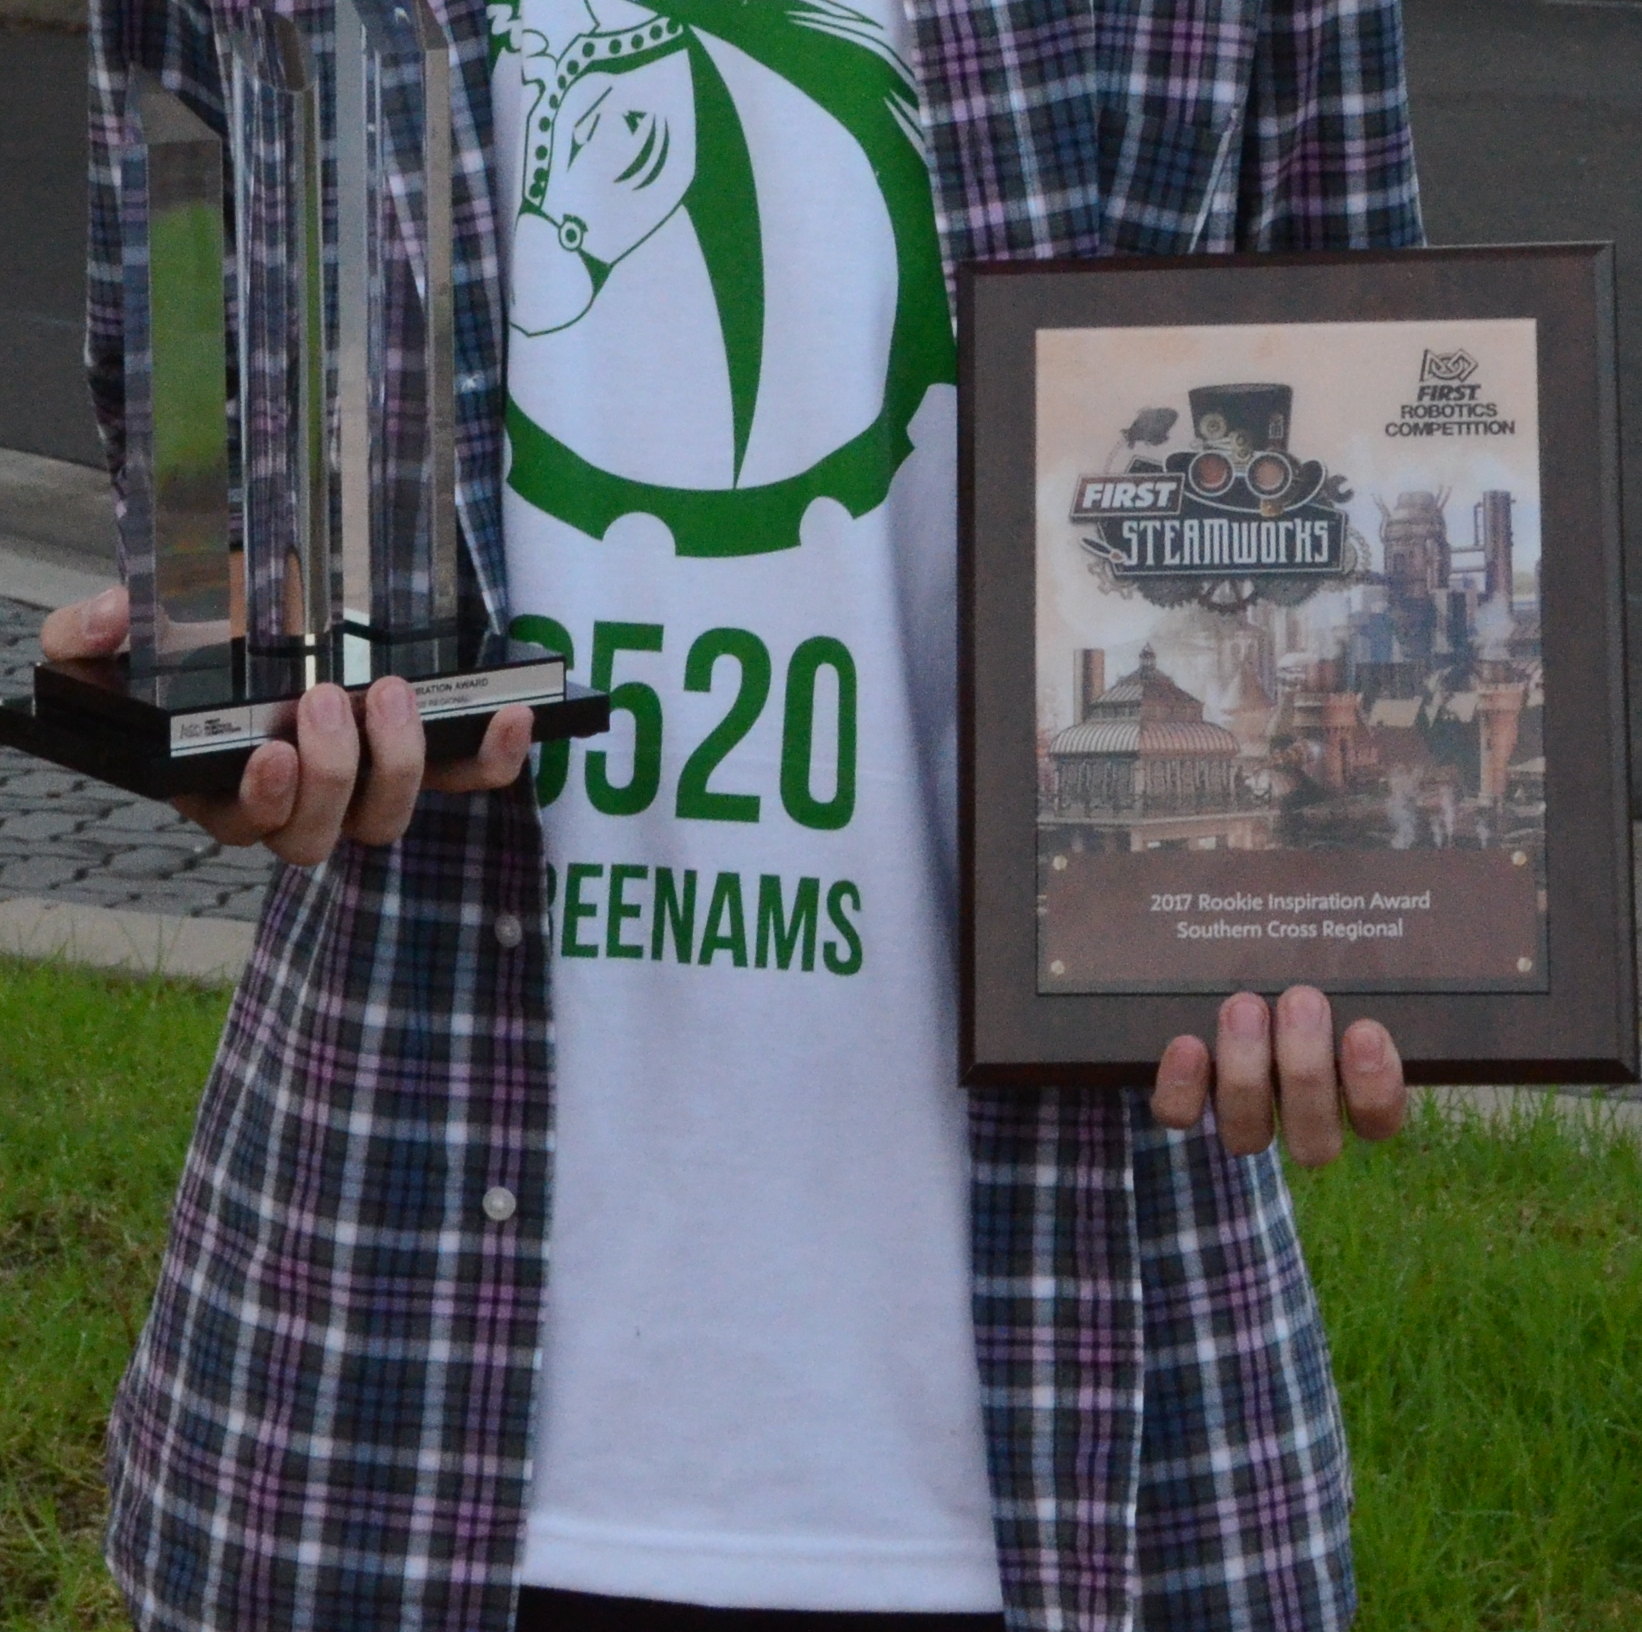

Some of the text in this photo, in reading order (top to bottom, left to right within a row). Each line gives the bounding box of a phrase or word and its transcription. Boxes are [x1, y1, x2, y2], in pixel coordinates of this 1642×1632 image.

[1417, 384, 1481, 401] FIRST
[1400, 403, 1498, 419] ROBOTICS
[1385, 420, 1516, 437] COMPETITION
[1082, 481, 1177, 509] FIRST
[1122, 518, 1329, 566] STEAMWORKS
[1150, 891, 1431, 913] 2017 Rookie Inspiration Award
[546, 861, 863, 977] EENAMS
[1177, 918, 1404, 941] Southern Cross Regional
